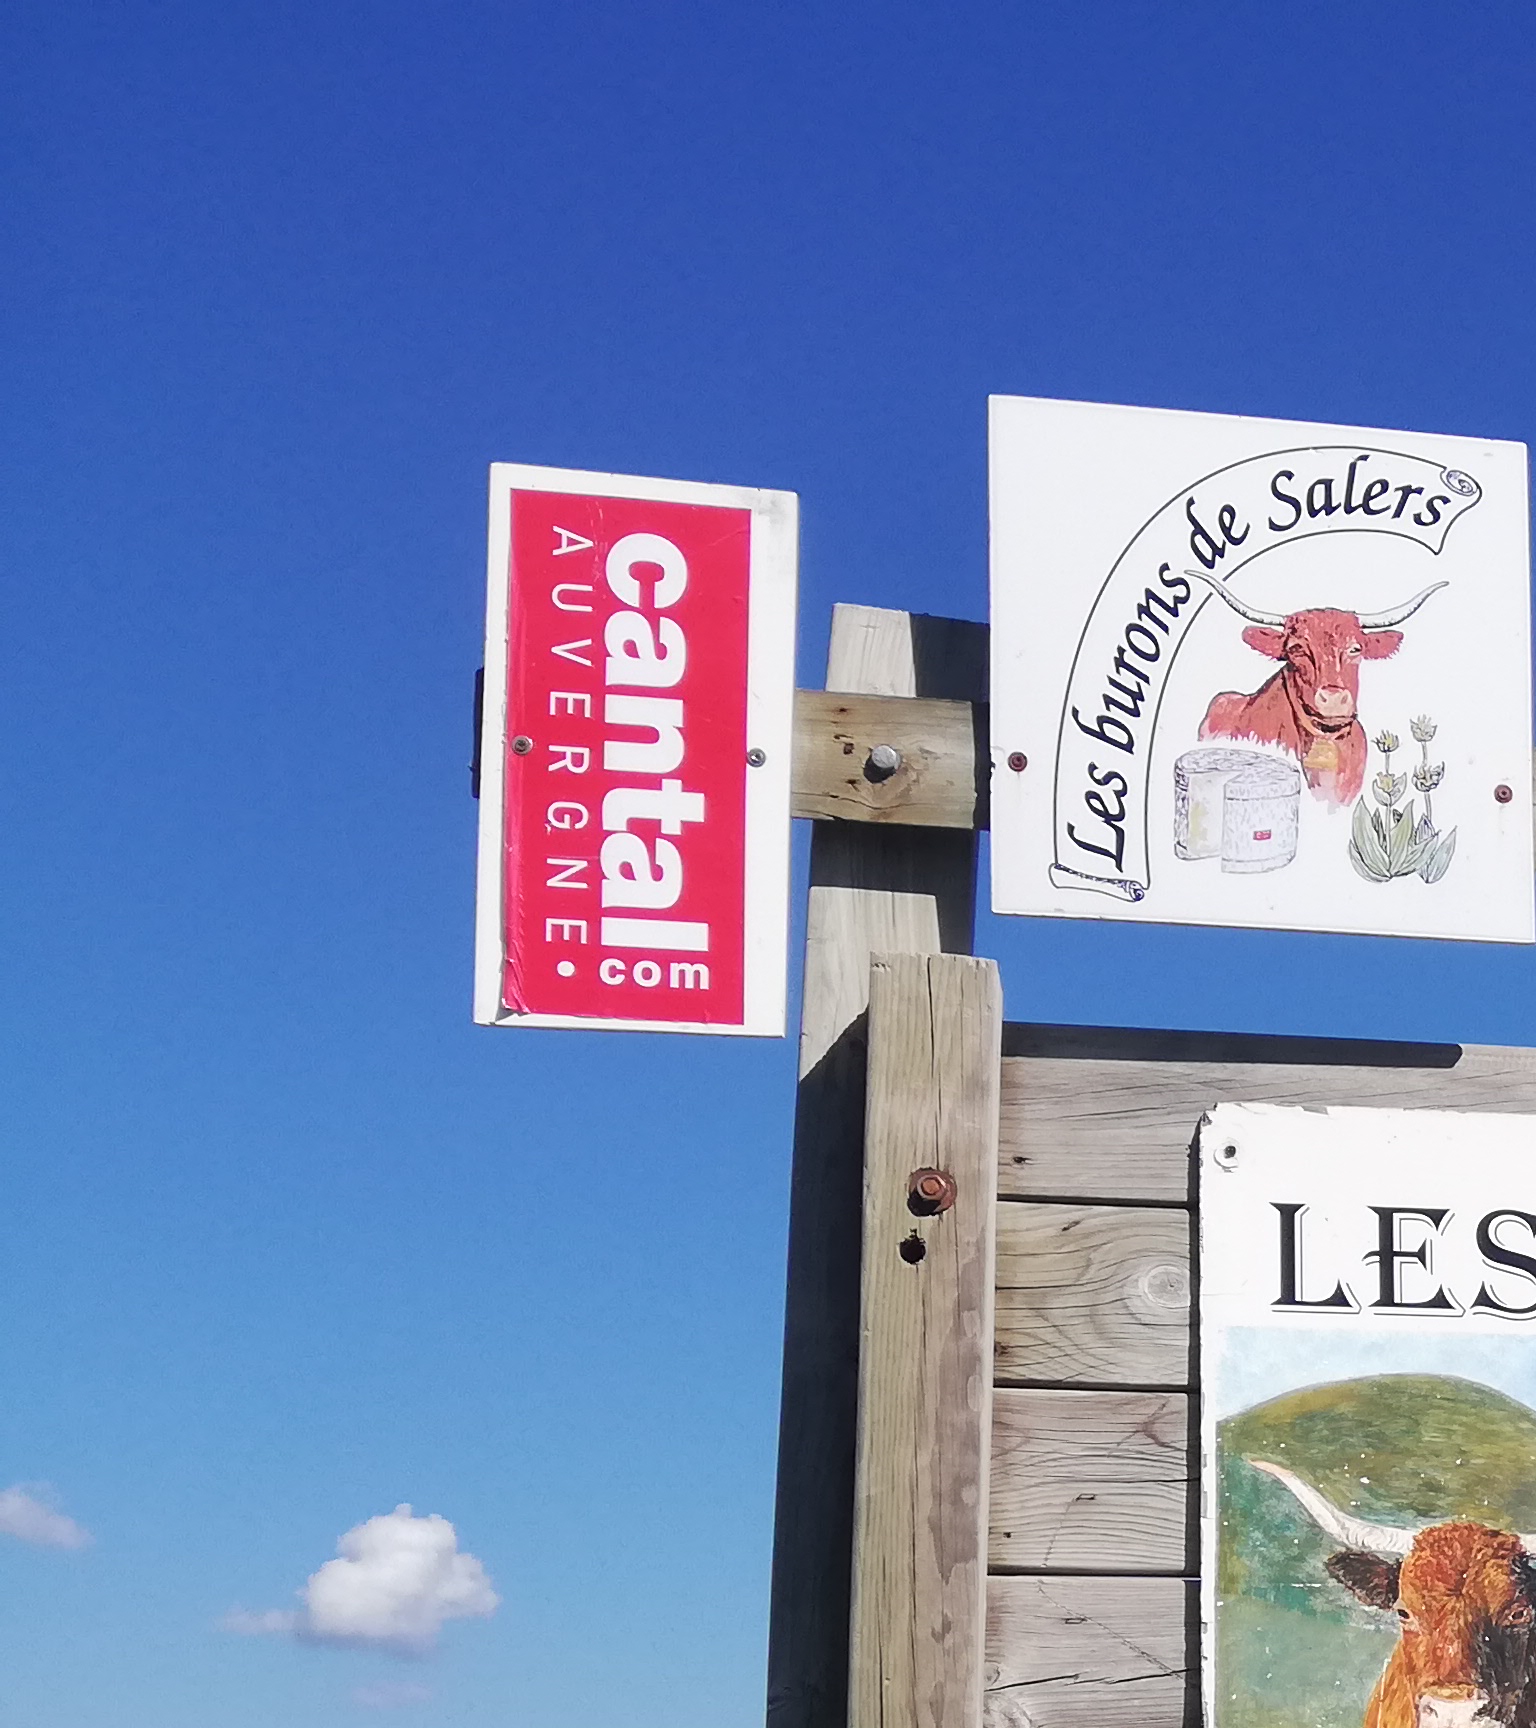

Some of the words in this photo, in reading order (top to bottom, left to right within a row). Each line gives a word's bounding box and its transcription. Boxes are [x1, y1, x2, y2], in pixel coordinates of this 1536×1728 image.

[1187, 497, 1250, 570] de
[1268, 454, 1451, 531] Salers
[1072, 562, 1190, 755] burons
[545, 525, 594, 945] AUVERGNE
[600, 532, 710, 952] cantal
[1067, 762, 1127, 872] Les
